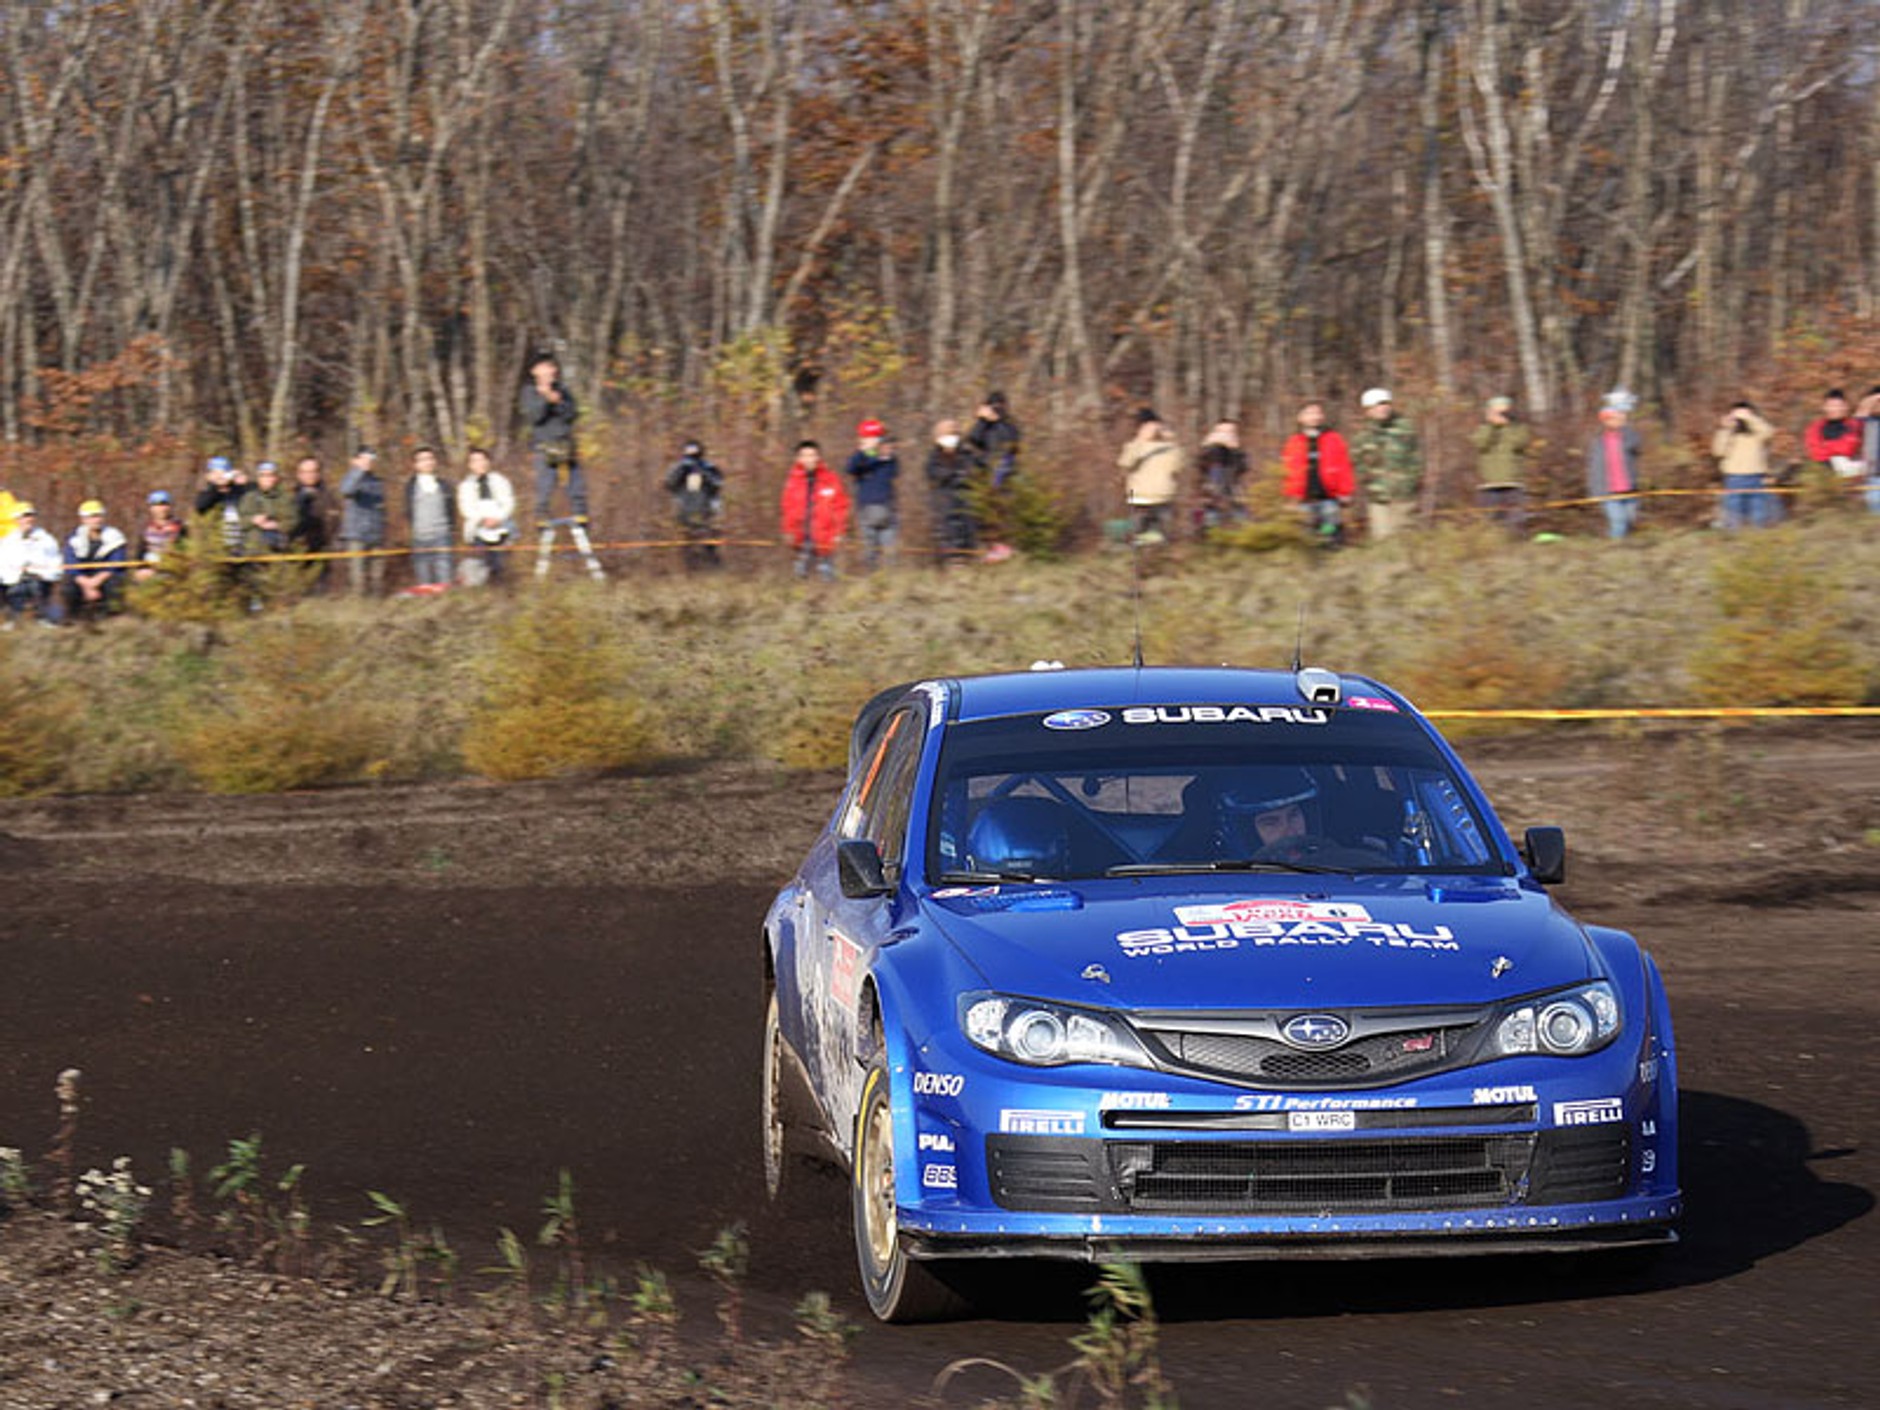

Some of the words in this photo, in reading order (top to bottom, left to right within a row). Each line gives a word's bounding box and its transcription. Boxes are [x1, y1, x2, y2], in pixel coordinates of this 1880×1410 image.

[1121, 705, 1328, 724] SUBARU
[1116, 921, 1454, 947] SUBARU
[1123, 939, 1239, 957] WORLD
[1254, 937, 1353, 946] RALLY
[1366, 937, 1459, 951] TEAM
[913, 1072, 964, 1096] DENSO
[1100, 1091, 1171, 1110] MOTUL
[1233, 1094, 1282, 1110] STI
[1284, 1097, 1418, 1109] Performance
[1472, 1086, 1538, 1103] MOTUL
[1292, 1113, 1311, 1126] C1
[1316, 1113, 1352, 1127] WRC
[1553, 1097, 1623, 1126] PIRELLI
[1000, 1109, 1085, 1134] PIRELLI
